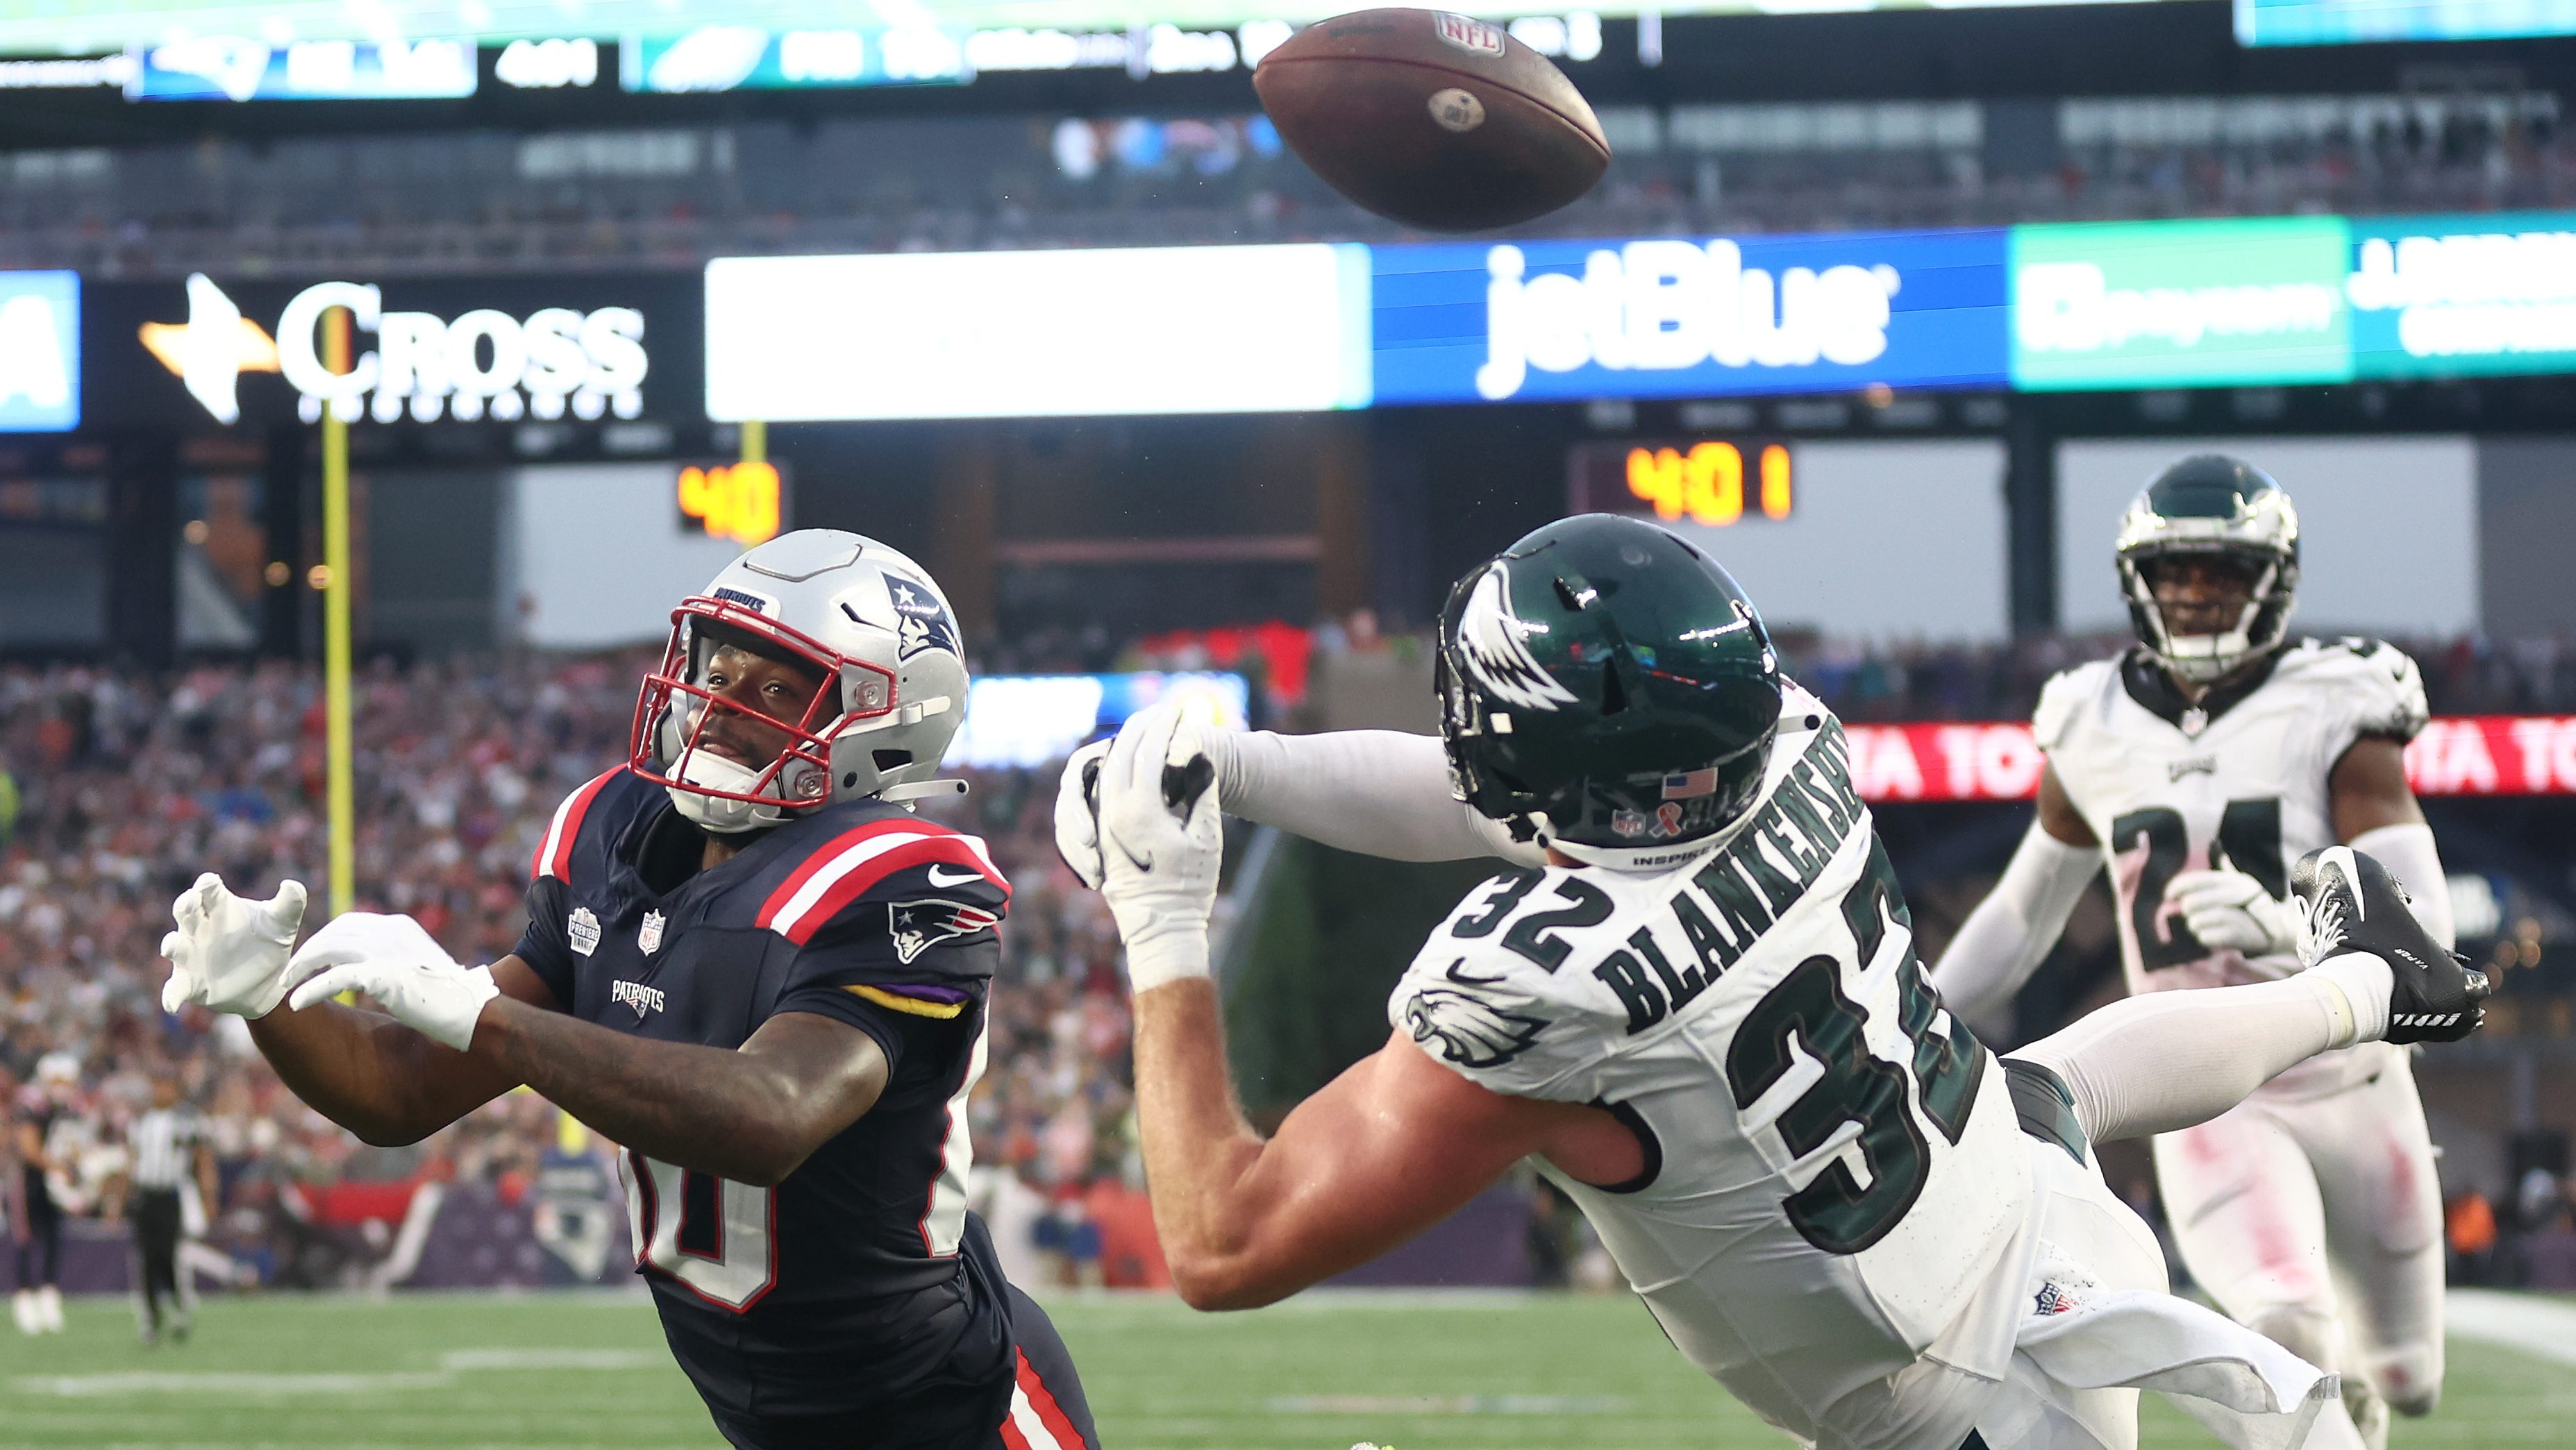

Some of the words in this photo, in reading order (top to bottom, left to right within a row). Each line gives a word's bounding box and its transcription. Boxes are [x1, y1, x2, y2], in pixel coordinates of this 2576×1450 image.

[1446, 20, 1496, 49] NFL
[1476, 239, 1891, 401] jetBlue
[1625, 441, 1791, 526] 4:01
[642, 929, 657, 947] NFL
[1451, 866, 1616, 976] 32
[2394, 948, 2429, 970] VAPOR
[612, 979, 664, 1013] PATRIOTS
[1726, 826, 1988, 1254] 32
[617, 1145, 778, 1315] 0
